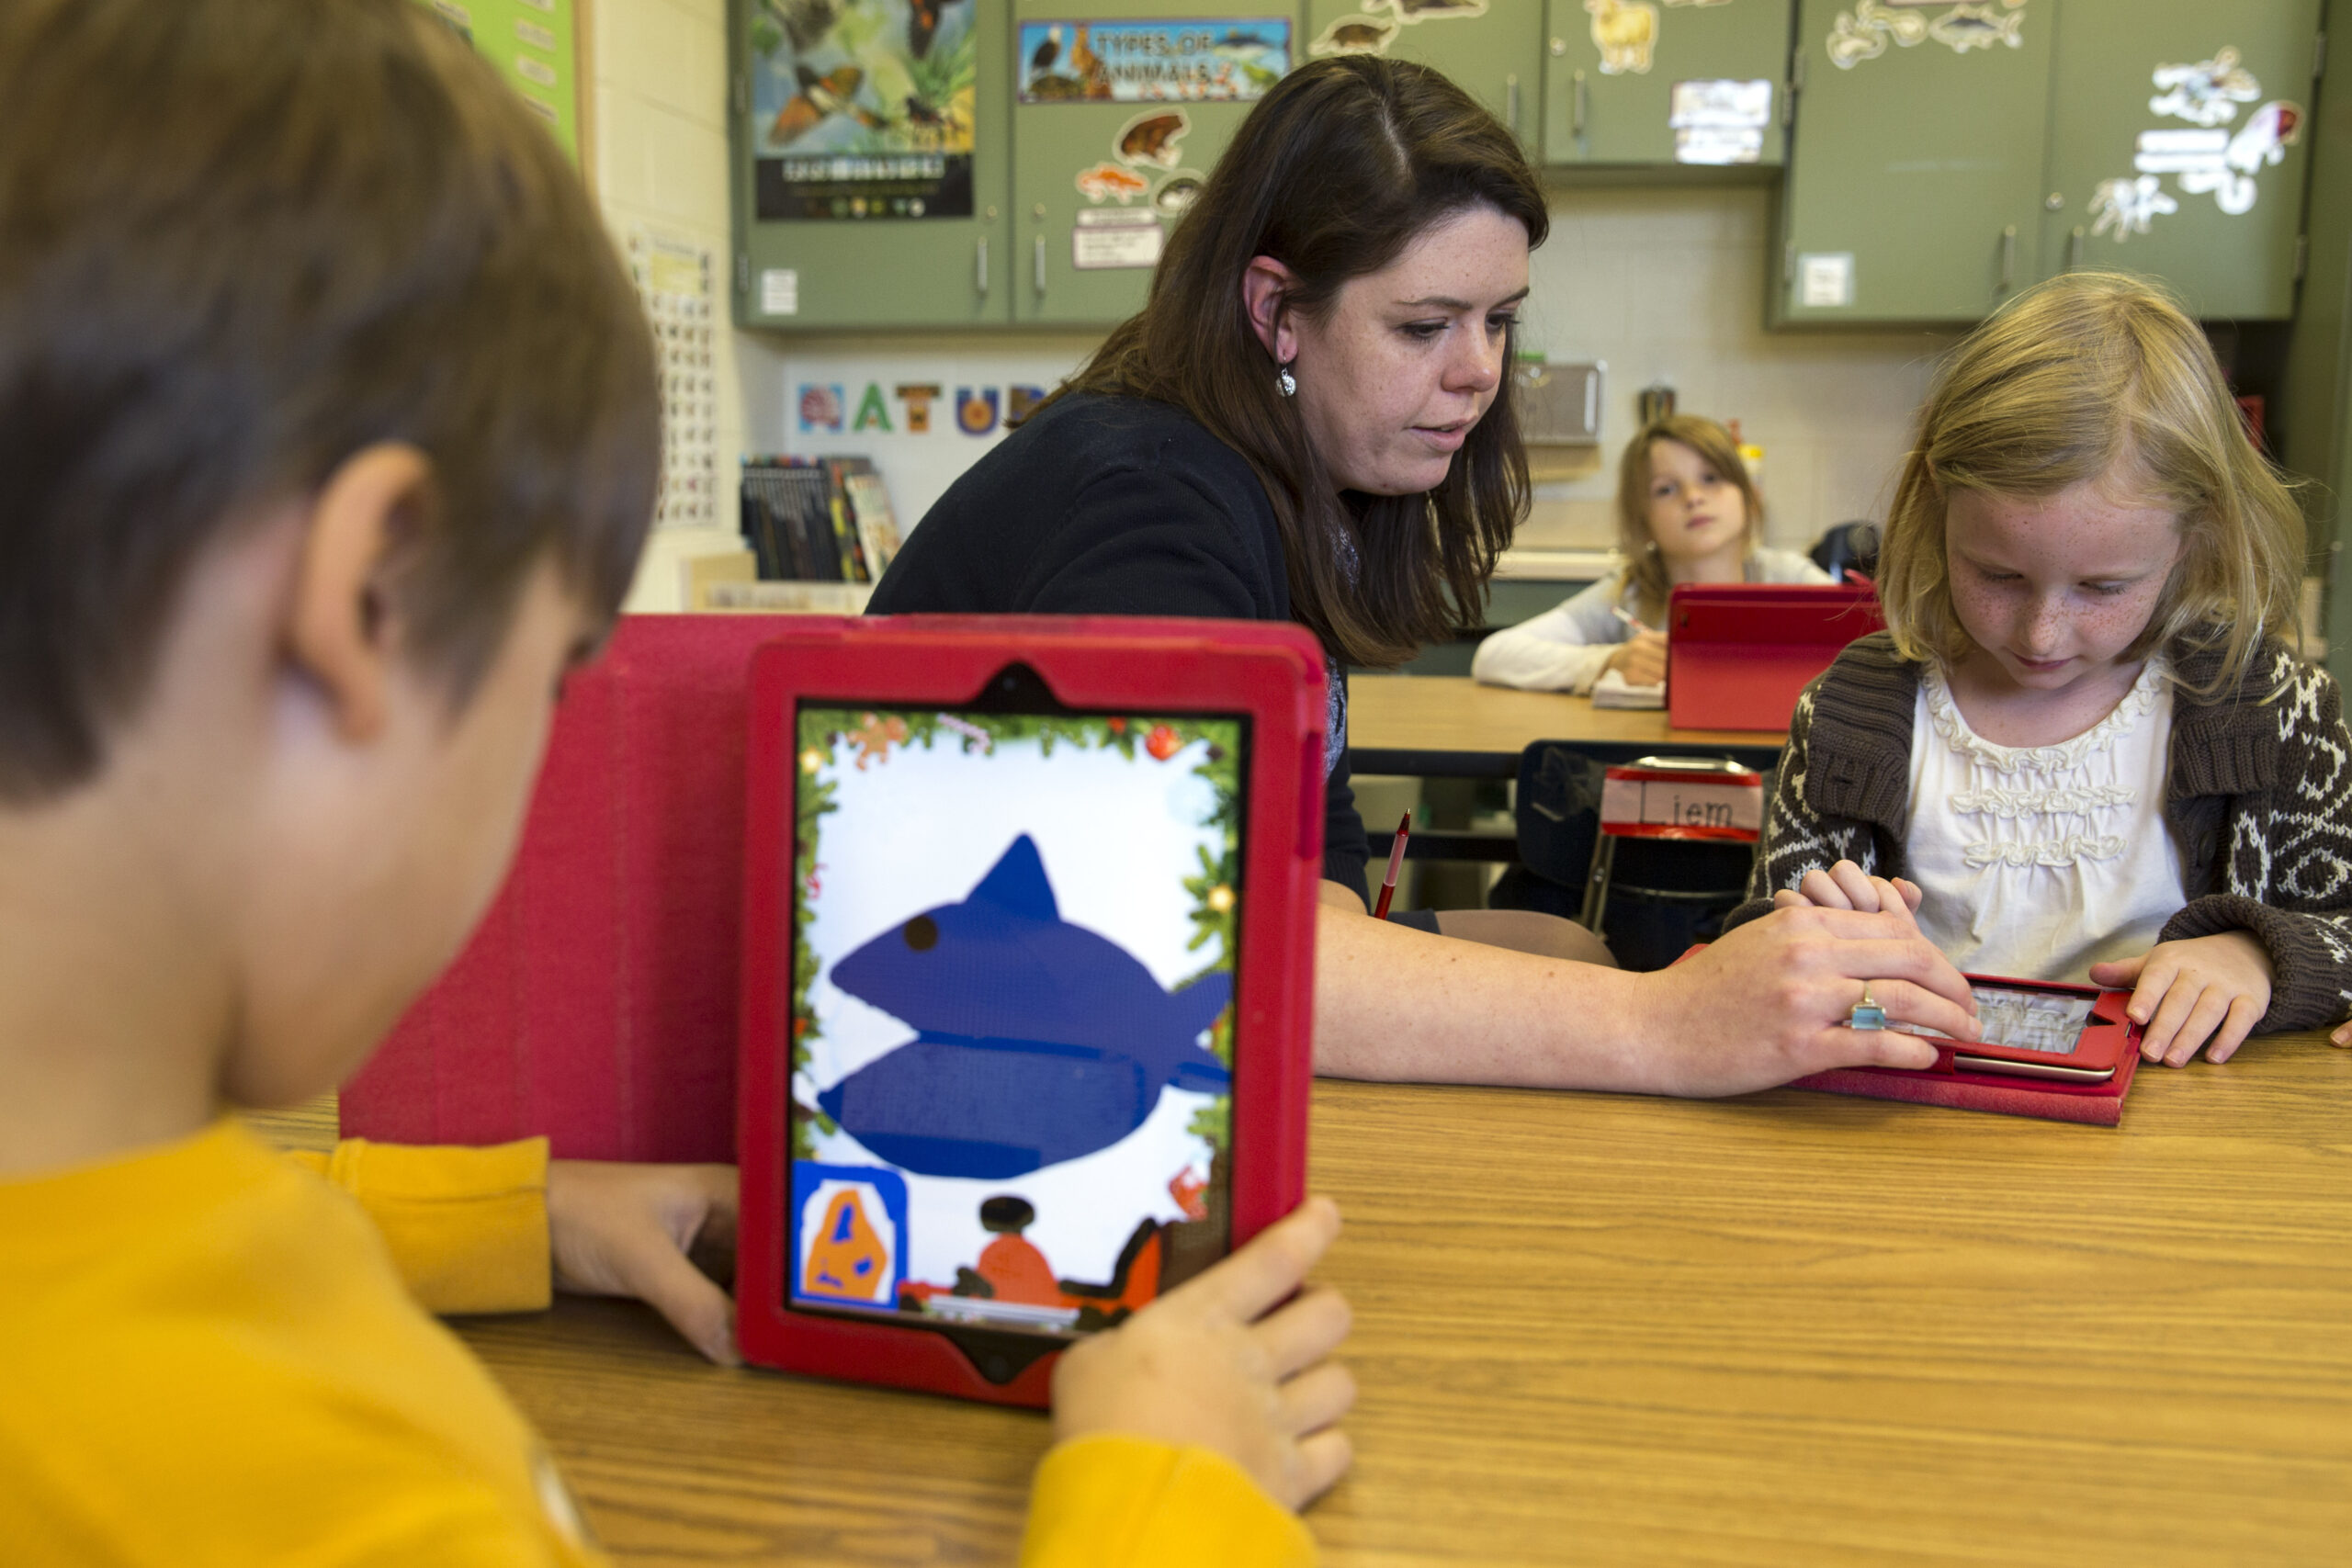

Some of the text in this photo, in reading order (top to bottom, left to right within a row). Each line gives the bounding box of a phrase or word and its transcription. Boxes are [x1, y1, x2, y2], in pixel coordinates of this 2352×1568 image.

[1096, 28, 1214, 56] TYPES OF
[1096, 62, 1213, 84] ANIMALS
[1638, 780, 1734, 828] Liem
